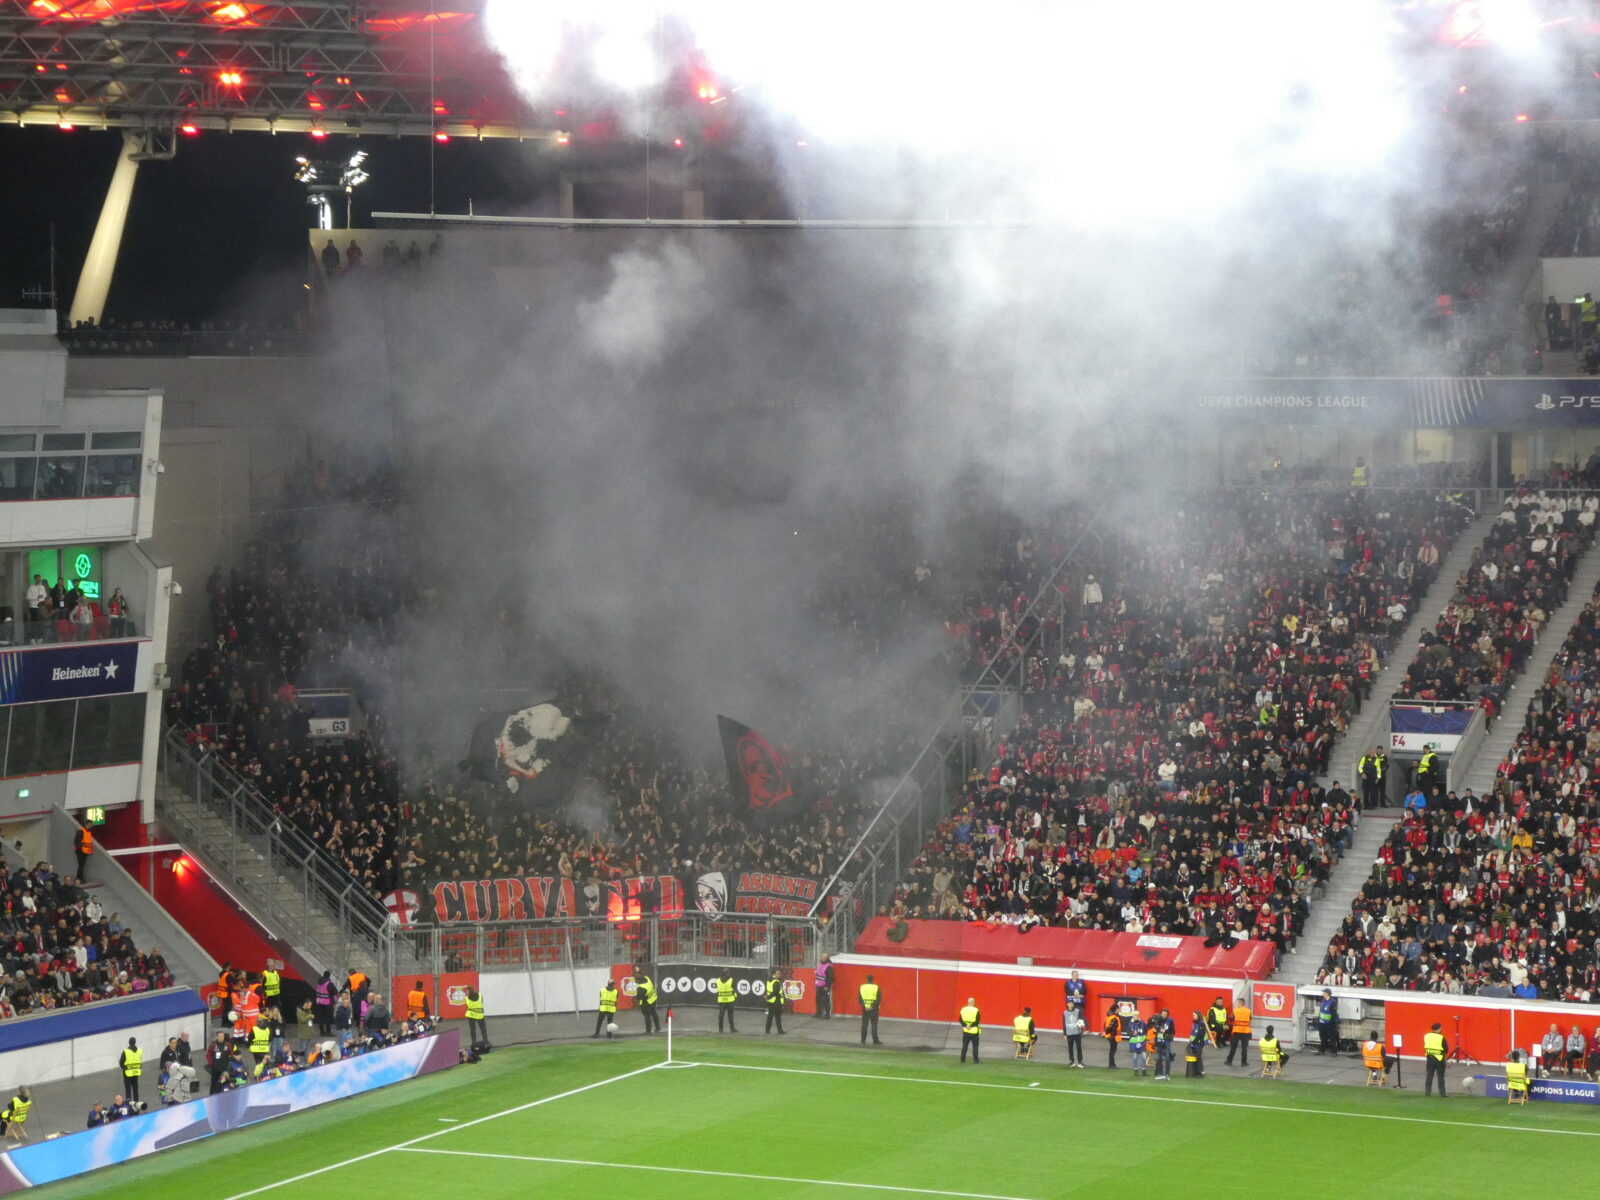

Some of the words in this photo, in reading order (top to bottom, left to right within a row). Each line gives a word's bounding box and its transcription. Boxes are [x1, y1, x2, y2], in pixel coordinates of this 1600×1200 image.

[1199, 396, 1232, 408] UEFA
[1236, 396, 1313, 408] CHAMPIONS
[1317, 396, 1368, 408] LEAGUE
[52, 665, 100, 681] Heineken
[332, 720, 346, 732] G3
[1392, 735, 1406, 747] F4
[433, 876, 577, 923] CURVA
[1565, 1088, 1595, 1097] LEAGUE
